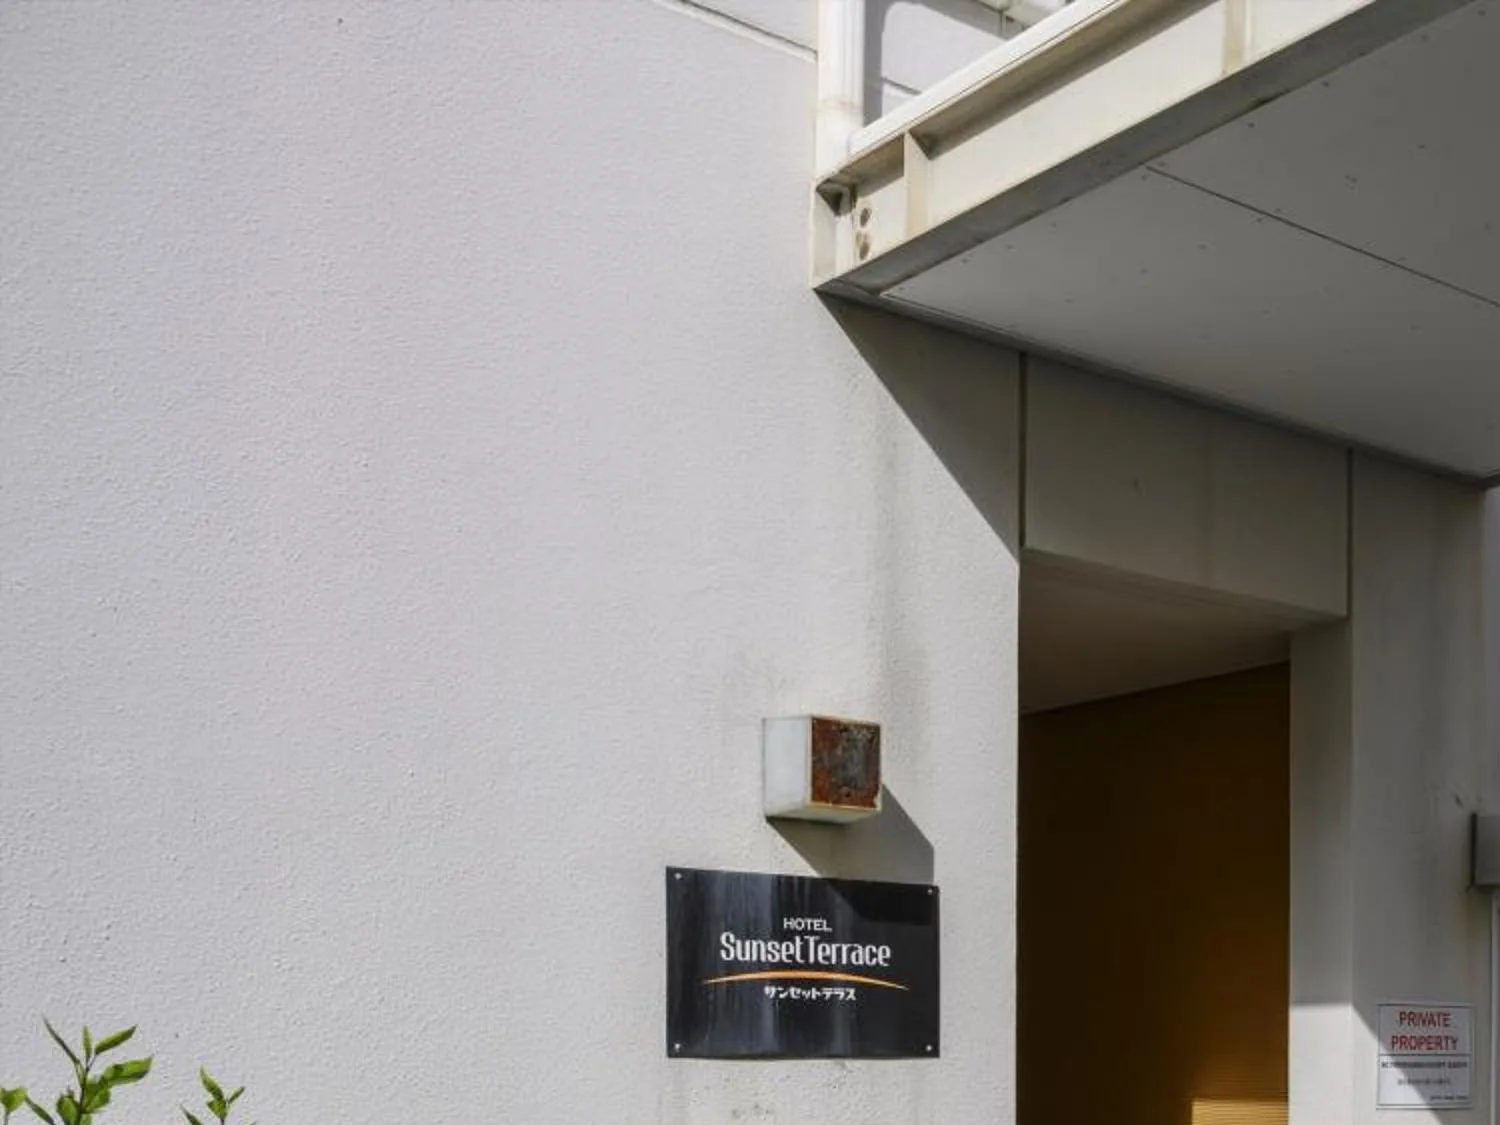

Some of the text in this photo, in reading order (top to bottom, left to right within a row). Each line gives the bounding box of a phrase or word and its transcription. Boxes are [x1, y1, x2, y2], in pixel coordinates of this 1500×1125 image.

[783, 917, 832, 932] HOTEL
[719, 931, 891, 967] Sunset Terrace
[764, 985, 857, 1001] サンセットテラス
[1400, 1011, 1452, 1028] PRIVATE
[1391, 1034, 1459, 1051] PROPERTY
